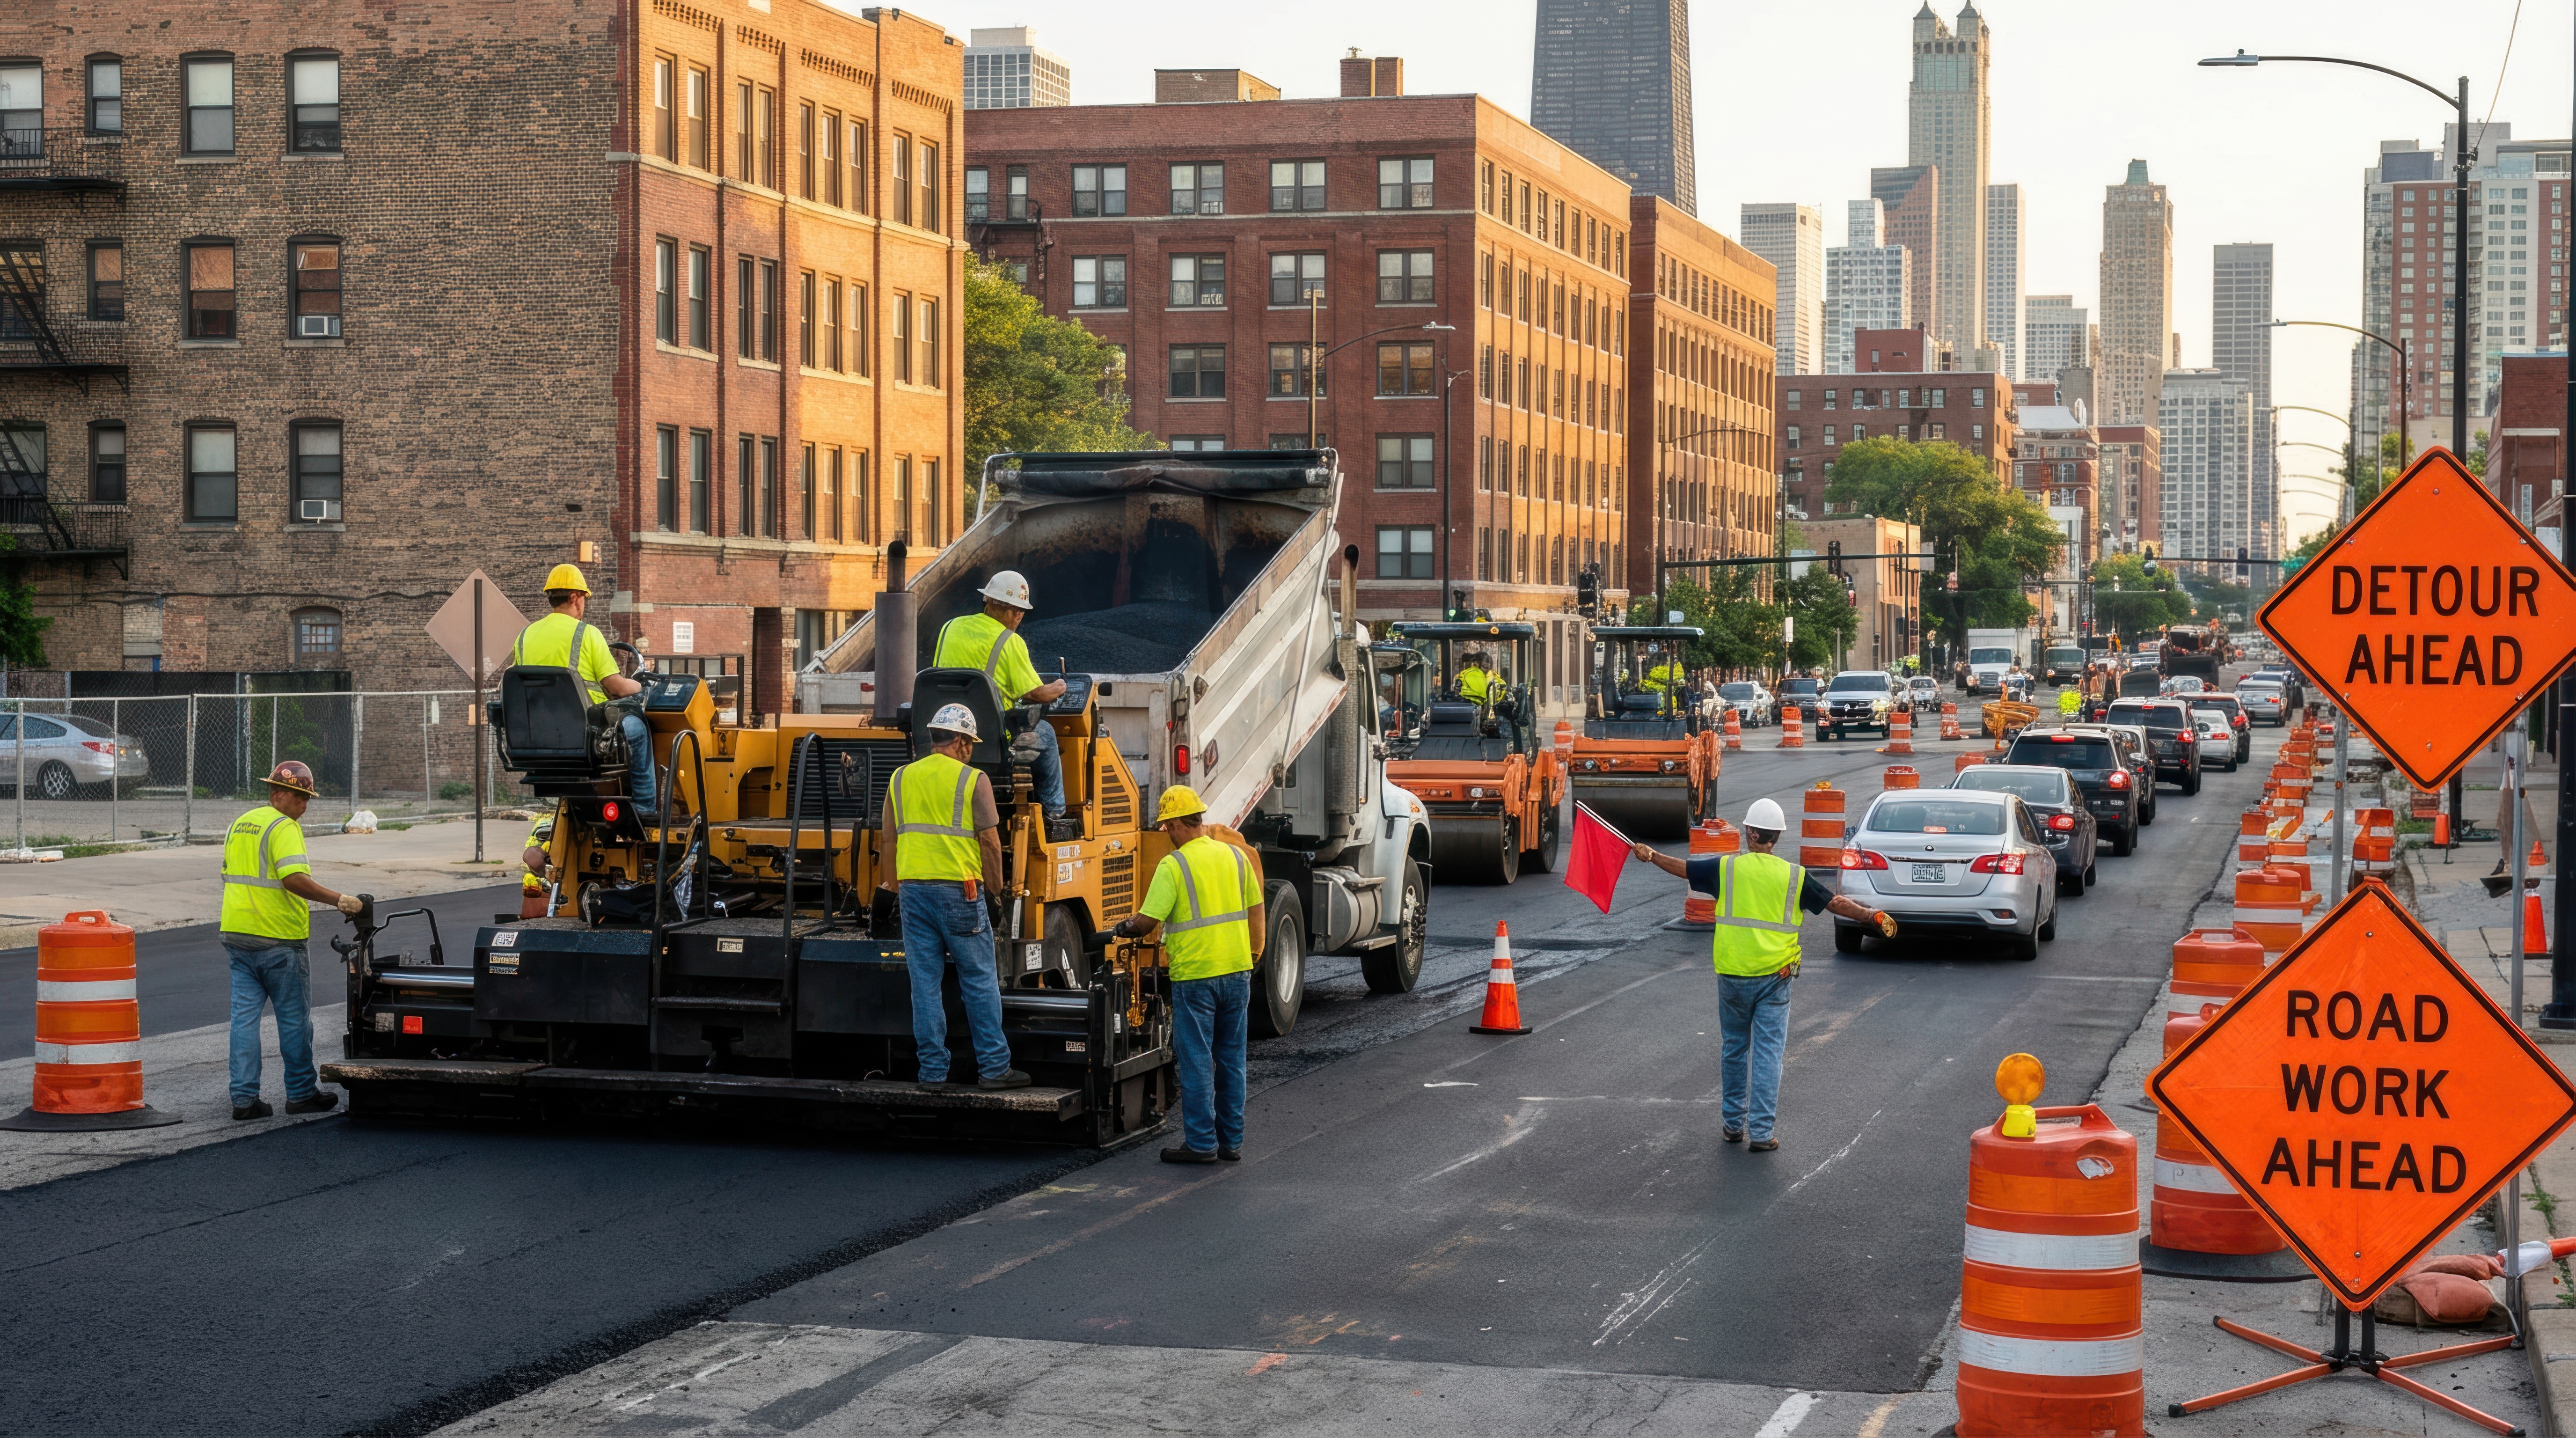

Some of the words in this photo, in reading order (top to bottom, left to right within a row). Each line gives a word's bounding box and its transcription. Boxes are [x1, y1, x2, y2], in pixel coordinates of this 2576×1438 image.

[2332, 565, 2539, 617] DETOUR
[2344, 634, 2523, 686] AHEAD
[2287, 990, 2448, 1042] ROAD
[2281, 1064, 2450, 1119] WORK
[2261, 1137, 2466, 1194] AHEAD
